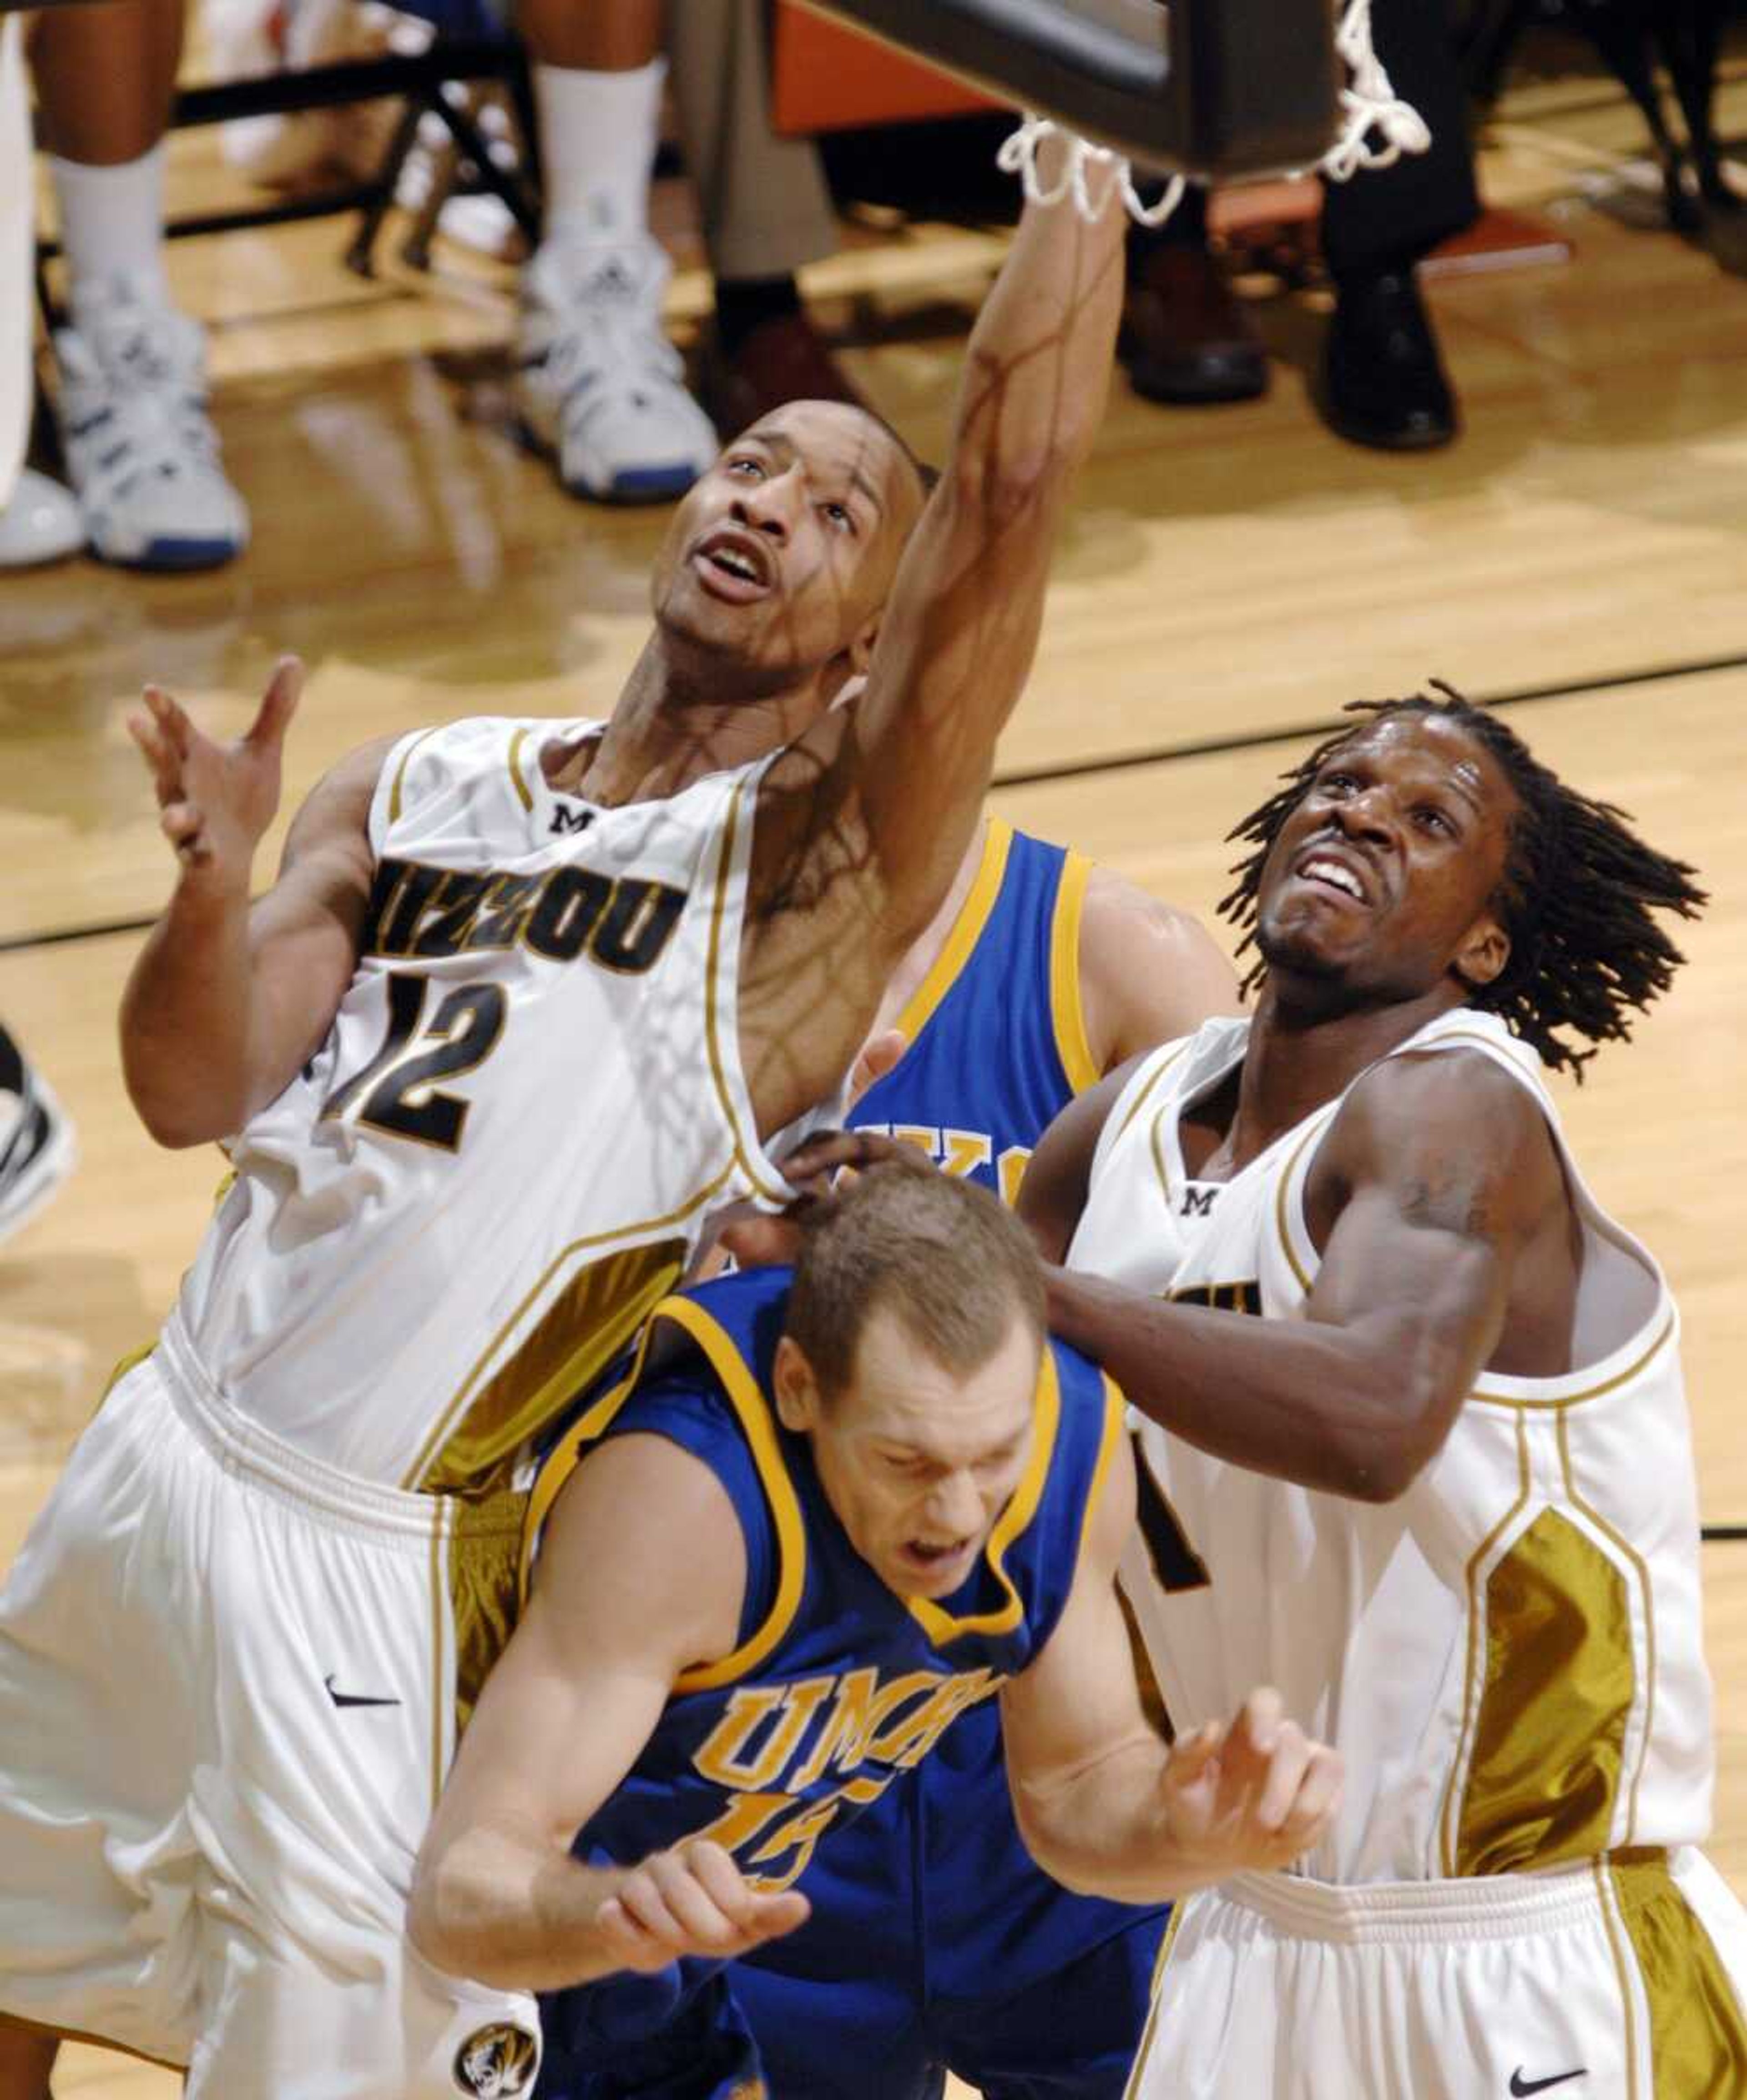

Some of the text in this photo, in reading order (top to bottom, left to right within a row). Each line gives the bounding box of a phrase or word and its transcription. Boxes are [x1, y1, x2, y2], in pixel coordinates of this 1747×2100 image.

[549, 803, 595, 834] M
[318, 971, 509, 1154] 12
[1180, 1186, 1219, 1216] M
